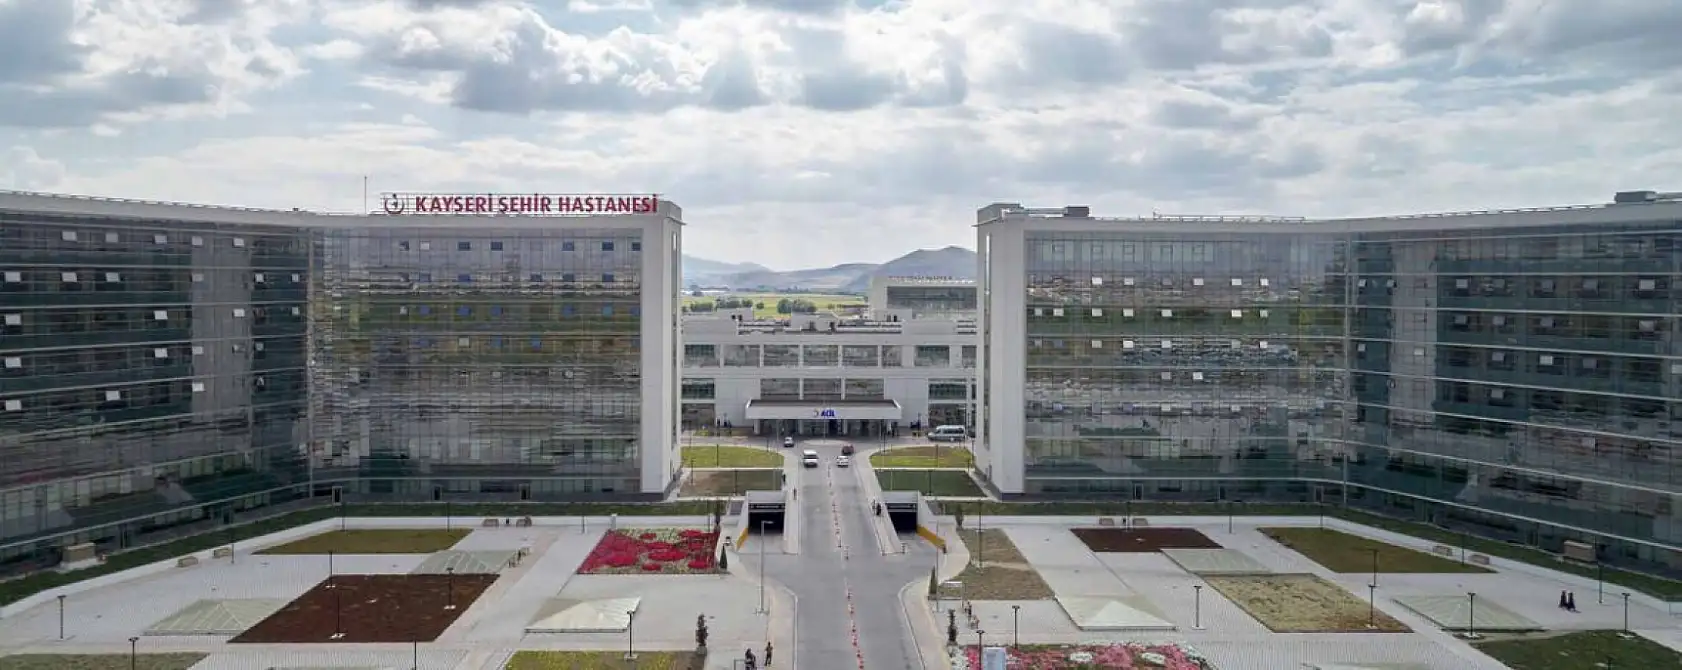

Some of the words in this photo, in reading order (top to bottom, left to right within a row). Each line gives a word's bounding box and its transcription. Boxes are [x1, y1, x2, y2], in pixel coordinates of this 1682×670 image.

[415, 193, 492, 212] KAYSERİ
[498, 193, 551, 214] ŞEHİR
[558, 193, 658, 212] HASTANESİ
